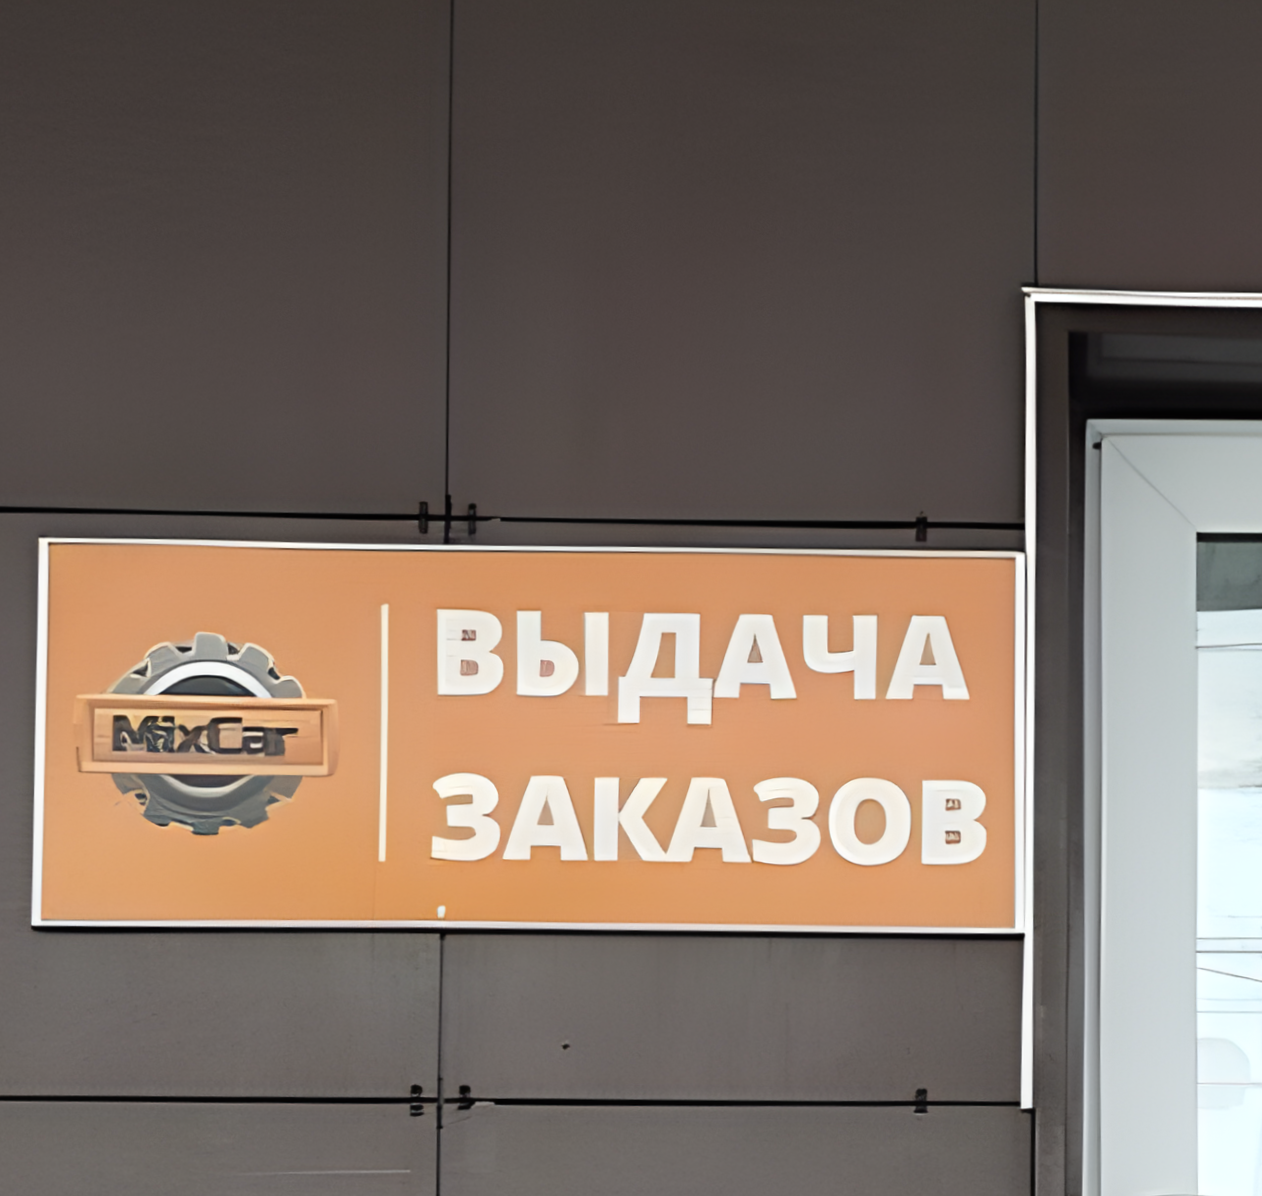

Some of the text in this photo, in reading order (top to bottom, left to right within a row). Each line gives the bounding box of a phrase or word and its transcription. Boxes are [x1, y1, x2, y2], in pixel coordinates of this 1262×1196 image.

[436, 608, 971, 725] ВЫДАЧА
[111, 713, 299, 757] MixCar
[430, 772, 987, 866] ЗАКАЗОВ
